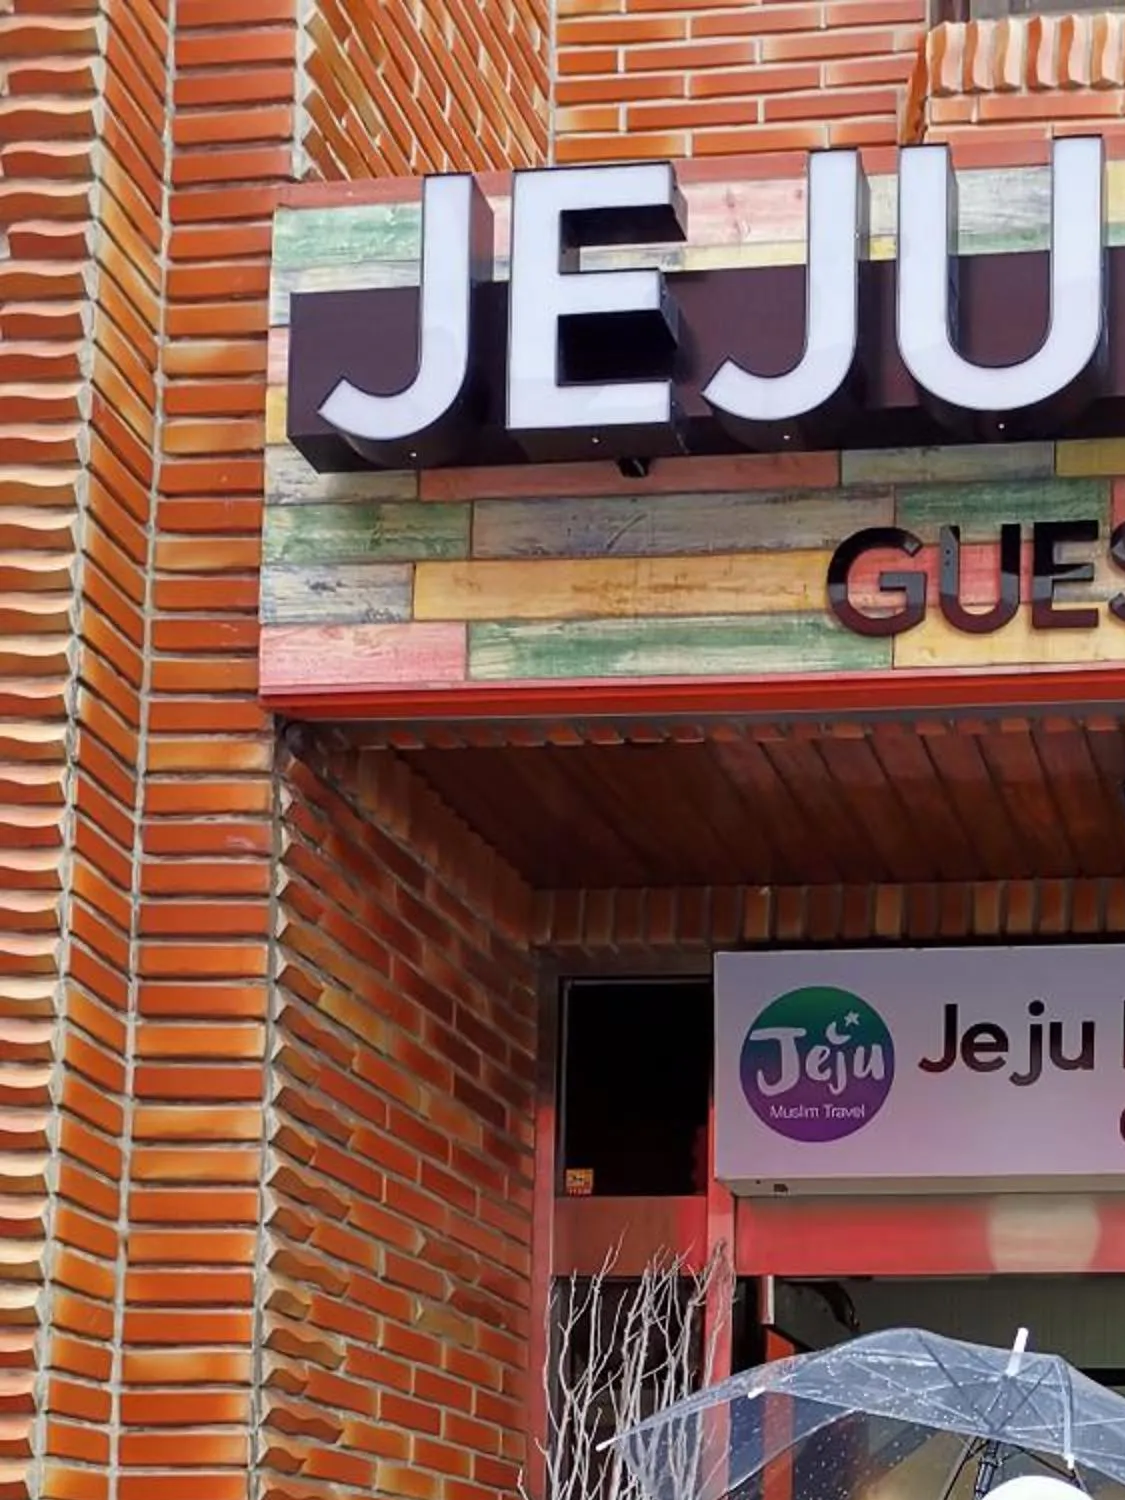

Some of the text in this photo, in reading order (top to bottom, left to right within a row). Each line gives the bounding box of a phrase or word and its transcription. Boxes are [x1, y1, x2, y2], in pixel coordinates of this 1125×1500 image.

[318, 133, 1104, 441] JEJU
[750, 1020, 886, 1097] Jeju
[918, 1000, 1096, 1086] Jeju
[769, 1103, 866, 1120] Muslim Travel
